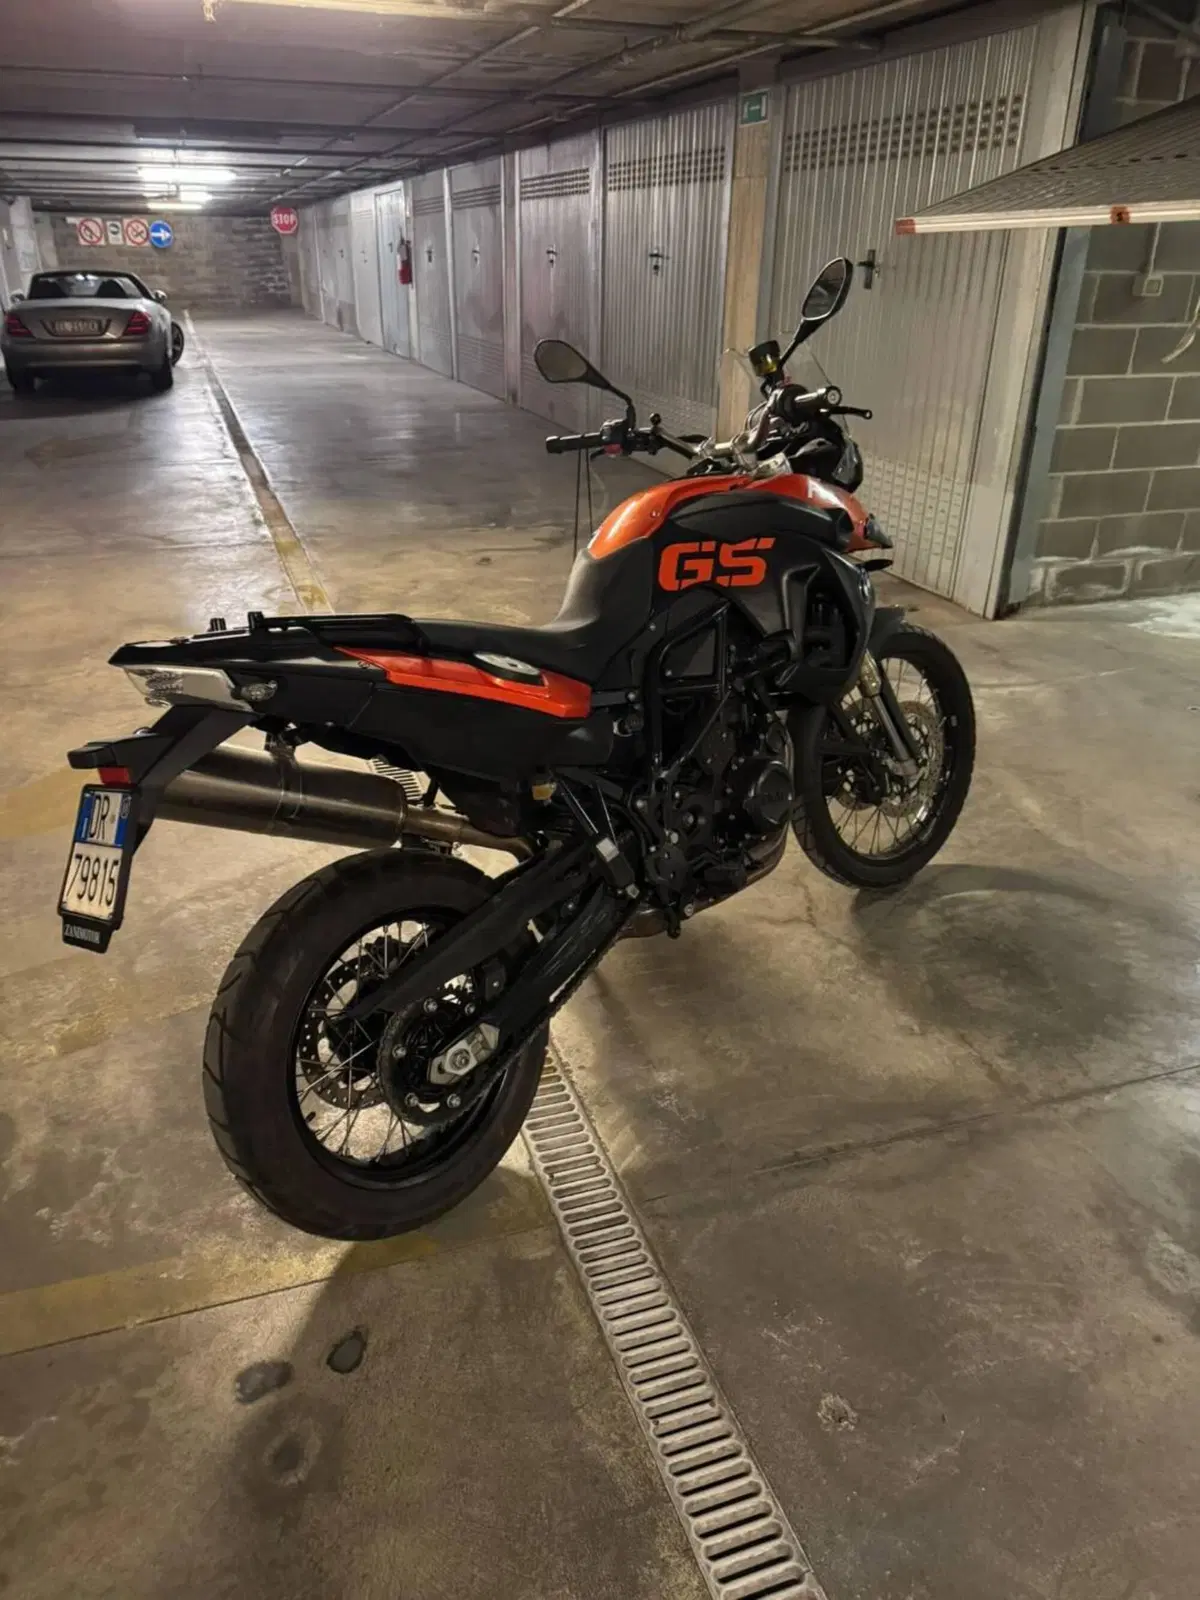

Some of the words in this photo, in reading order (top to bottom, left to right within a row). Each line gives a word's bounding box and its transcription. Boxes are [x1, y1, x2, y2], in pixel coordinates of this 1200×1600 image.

[271, 212, 297, 224] STOP
[658, 537, 776, 592] GS
[89, 794, 110, 839] DR
[66, 854, 119, 907] 79815
